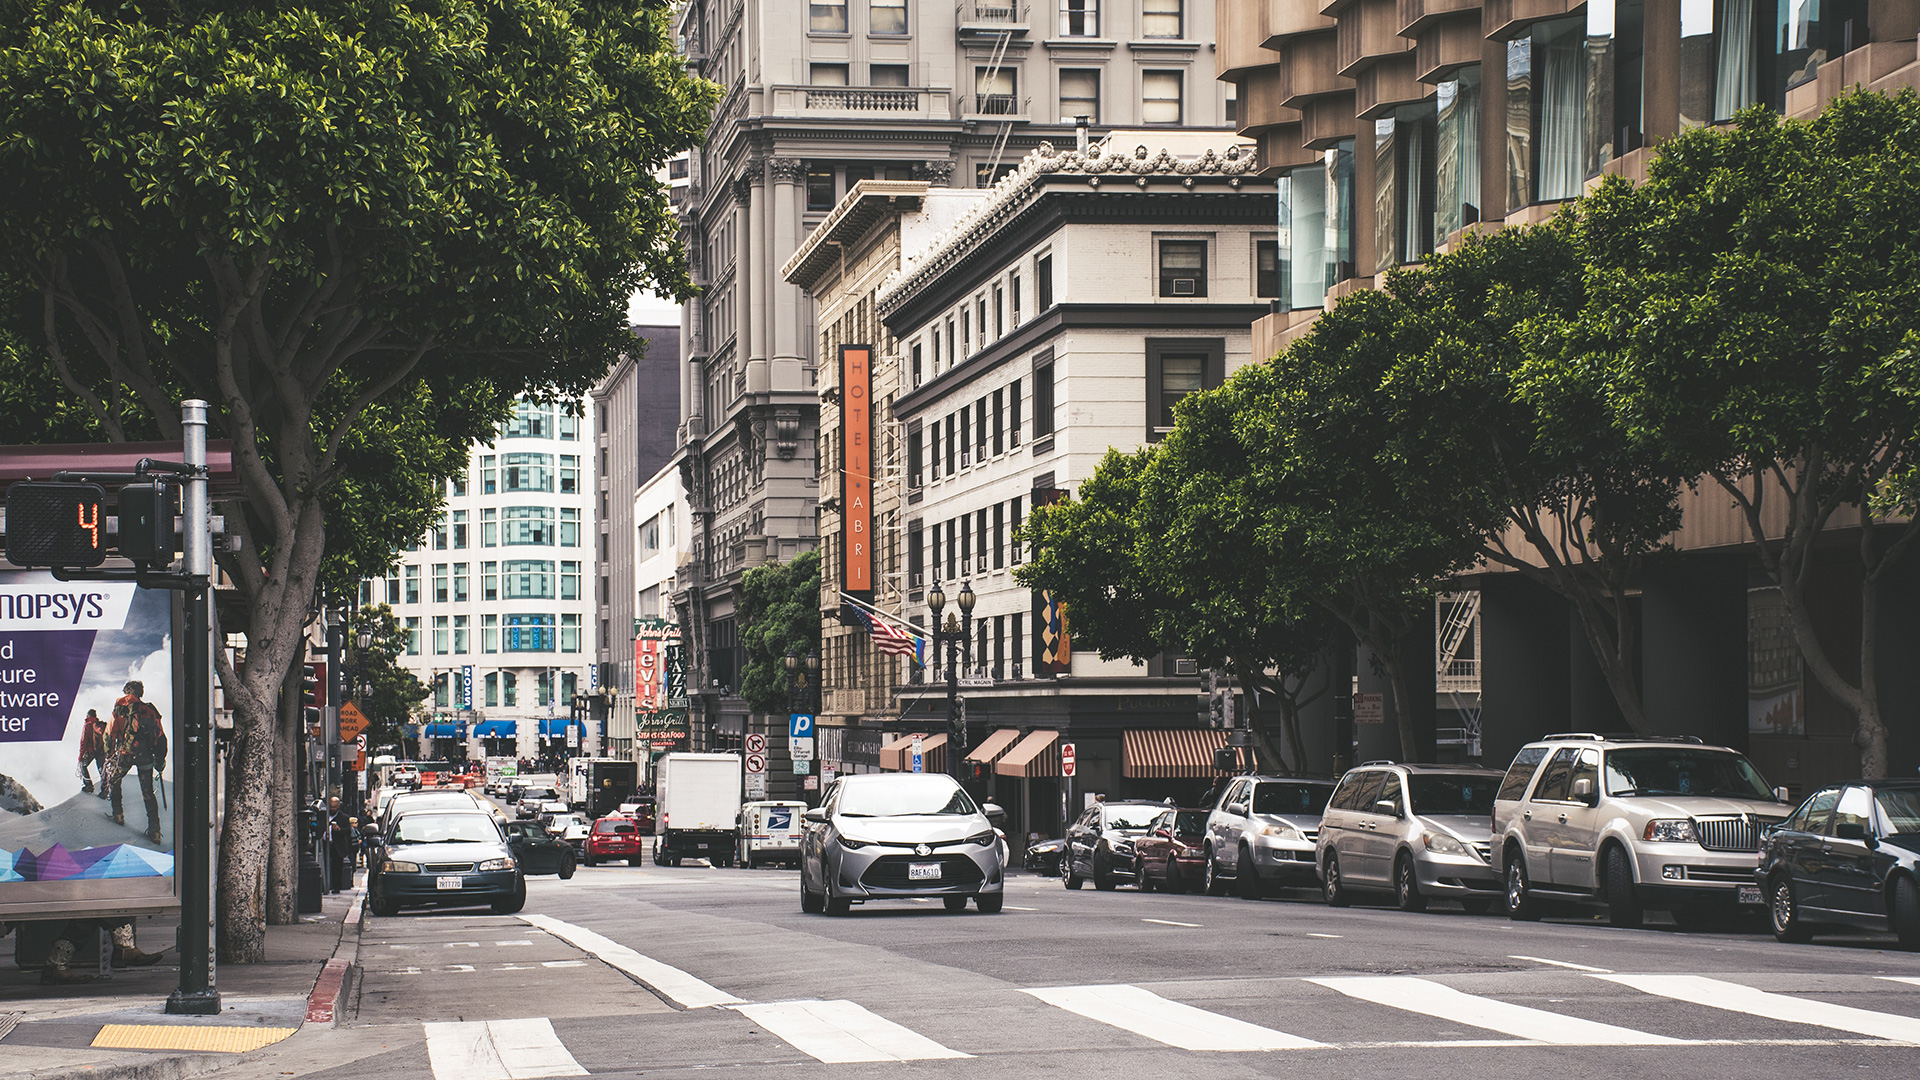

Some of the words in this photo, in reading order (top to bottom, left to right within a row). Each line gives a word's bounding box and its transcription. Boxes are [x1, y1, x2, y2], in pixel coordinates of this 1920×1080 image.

[851, 361, 864, 470] HOTEL
[78, 502, 98, 549] 4
[852, 497, 864, 579] ABRI
[636, 624, 662, 640] John's
[0, 668, 36, 683] ure
[464, 667, 472, 706] ROSS
[672, 646, 683, 698] JAZZ
[663, 713, 686, 729] Grill
[1117, 696, 1177, 710] PUCCINI
